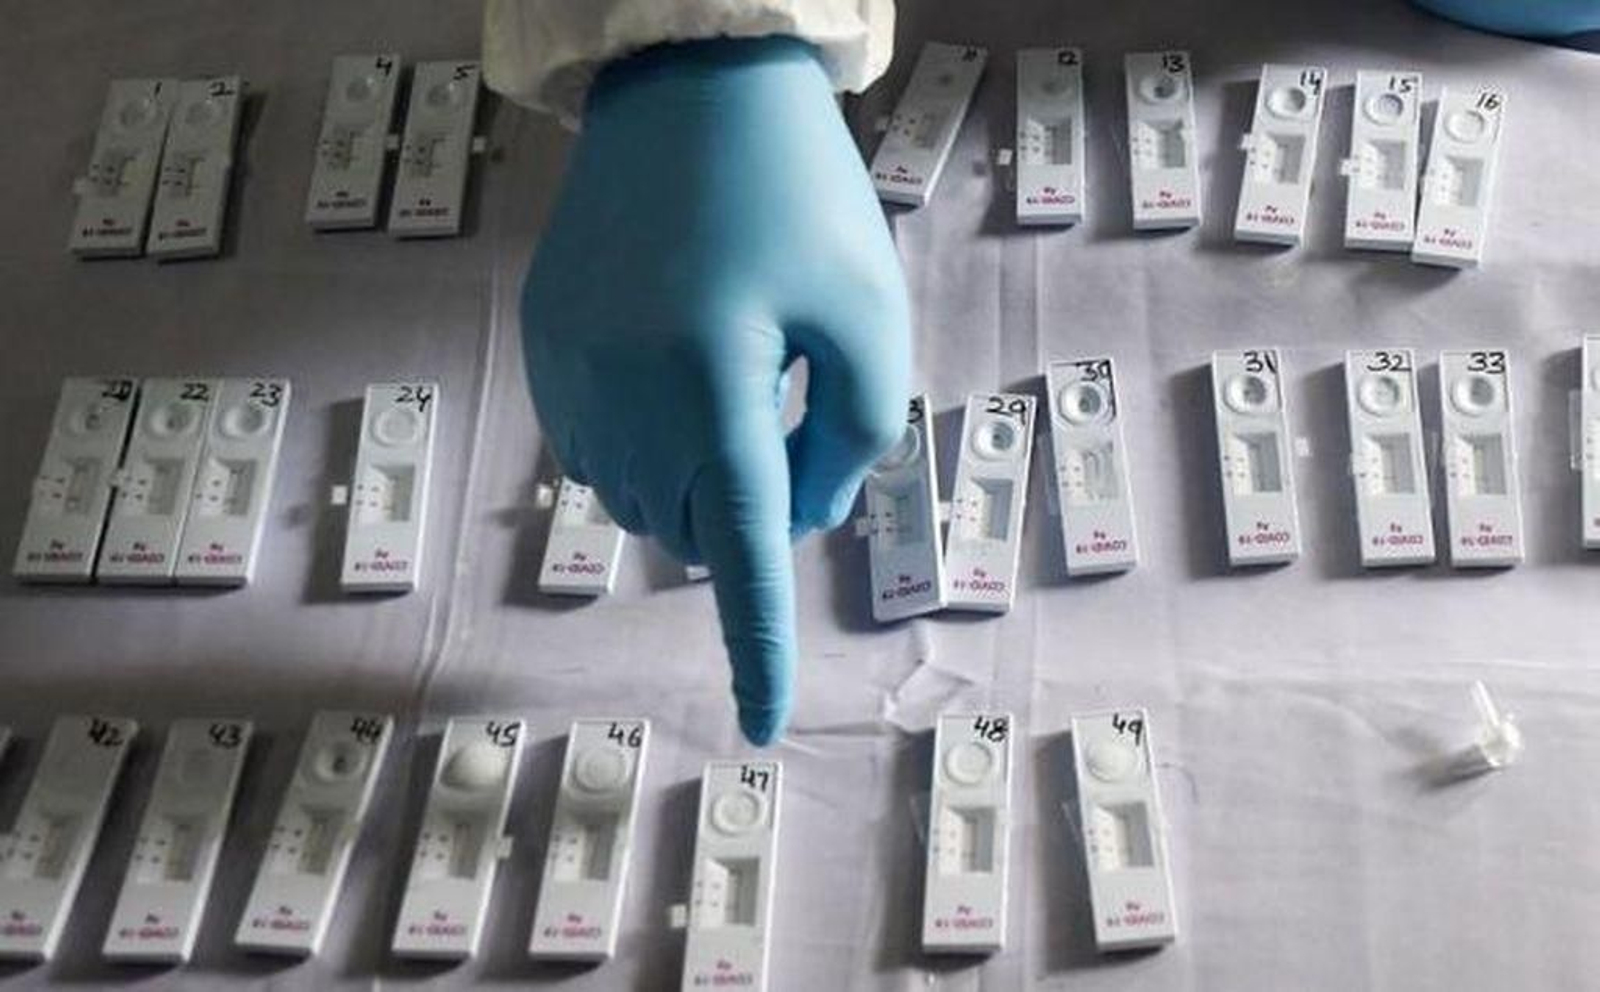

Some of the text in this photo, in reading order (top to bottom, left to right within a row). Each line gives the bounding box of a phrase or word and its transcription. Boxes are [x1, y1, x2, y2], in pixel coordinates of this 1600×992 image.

[375, 57, 392, 76] 4
[453, 65, 477, 81] 5
[1161, 55, 1185, 73] 13
[209, 82, 236, 97] 2
[1300, 70, 1321, 96] 14
[1389, 76, 1419, 93] 15
[1476, 93, 1500, 111] 16
[1244, 351, 1277, 374] 31
[1367, 352, 1412, 372] 32
[1467, 351, 1507, 374] 33
[179, 382, 210, 402] 22
[250, 382, 284, 408] 23
[396, 385, 432, 412] 24
[986, 396, 1028, 426] 29
[87, 718, 124, 747] 42
[208, 723, 243, 748] 43
[351, 717, 384, 744] 44
[485, 720, 520, 748] 45
[607, 721, 642, 748] 46
[973, 716, 1009, 742] 48
[1112, 713, 1144, 746] 49
[740, 764, 769, 791] 47
